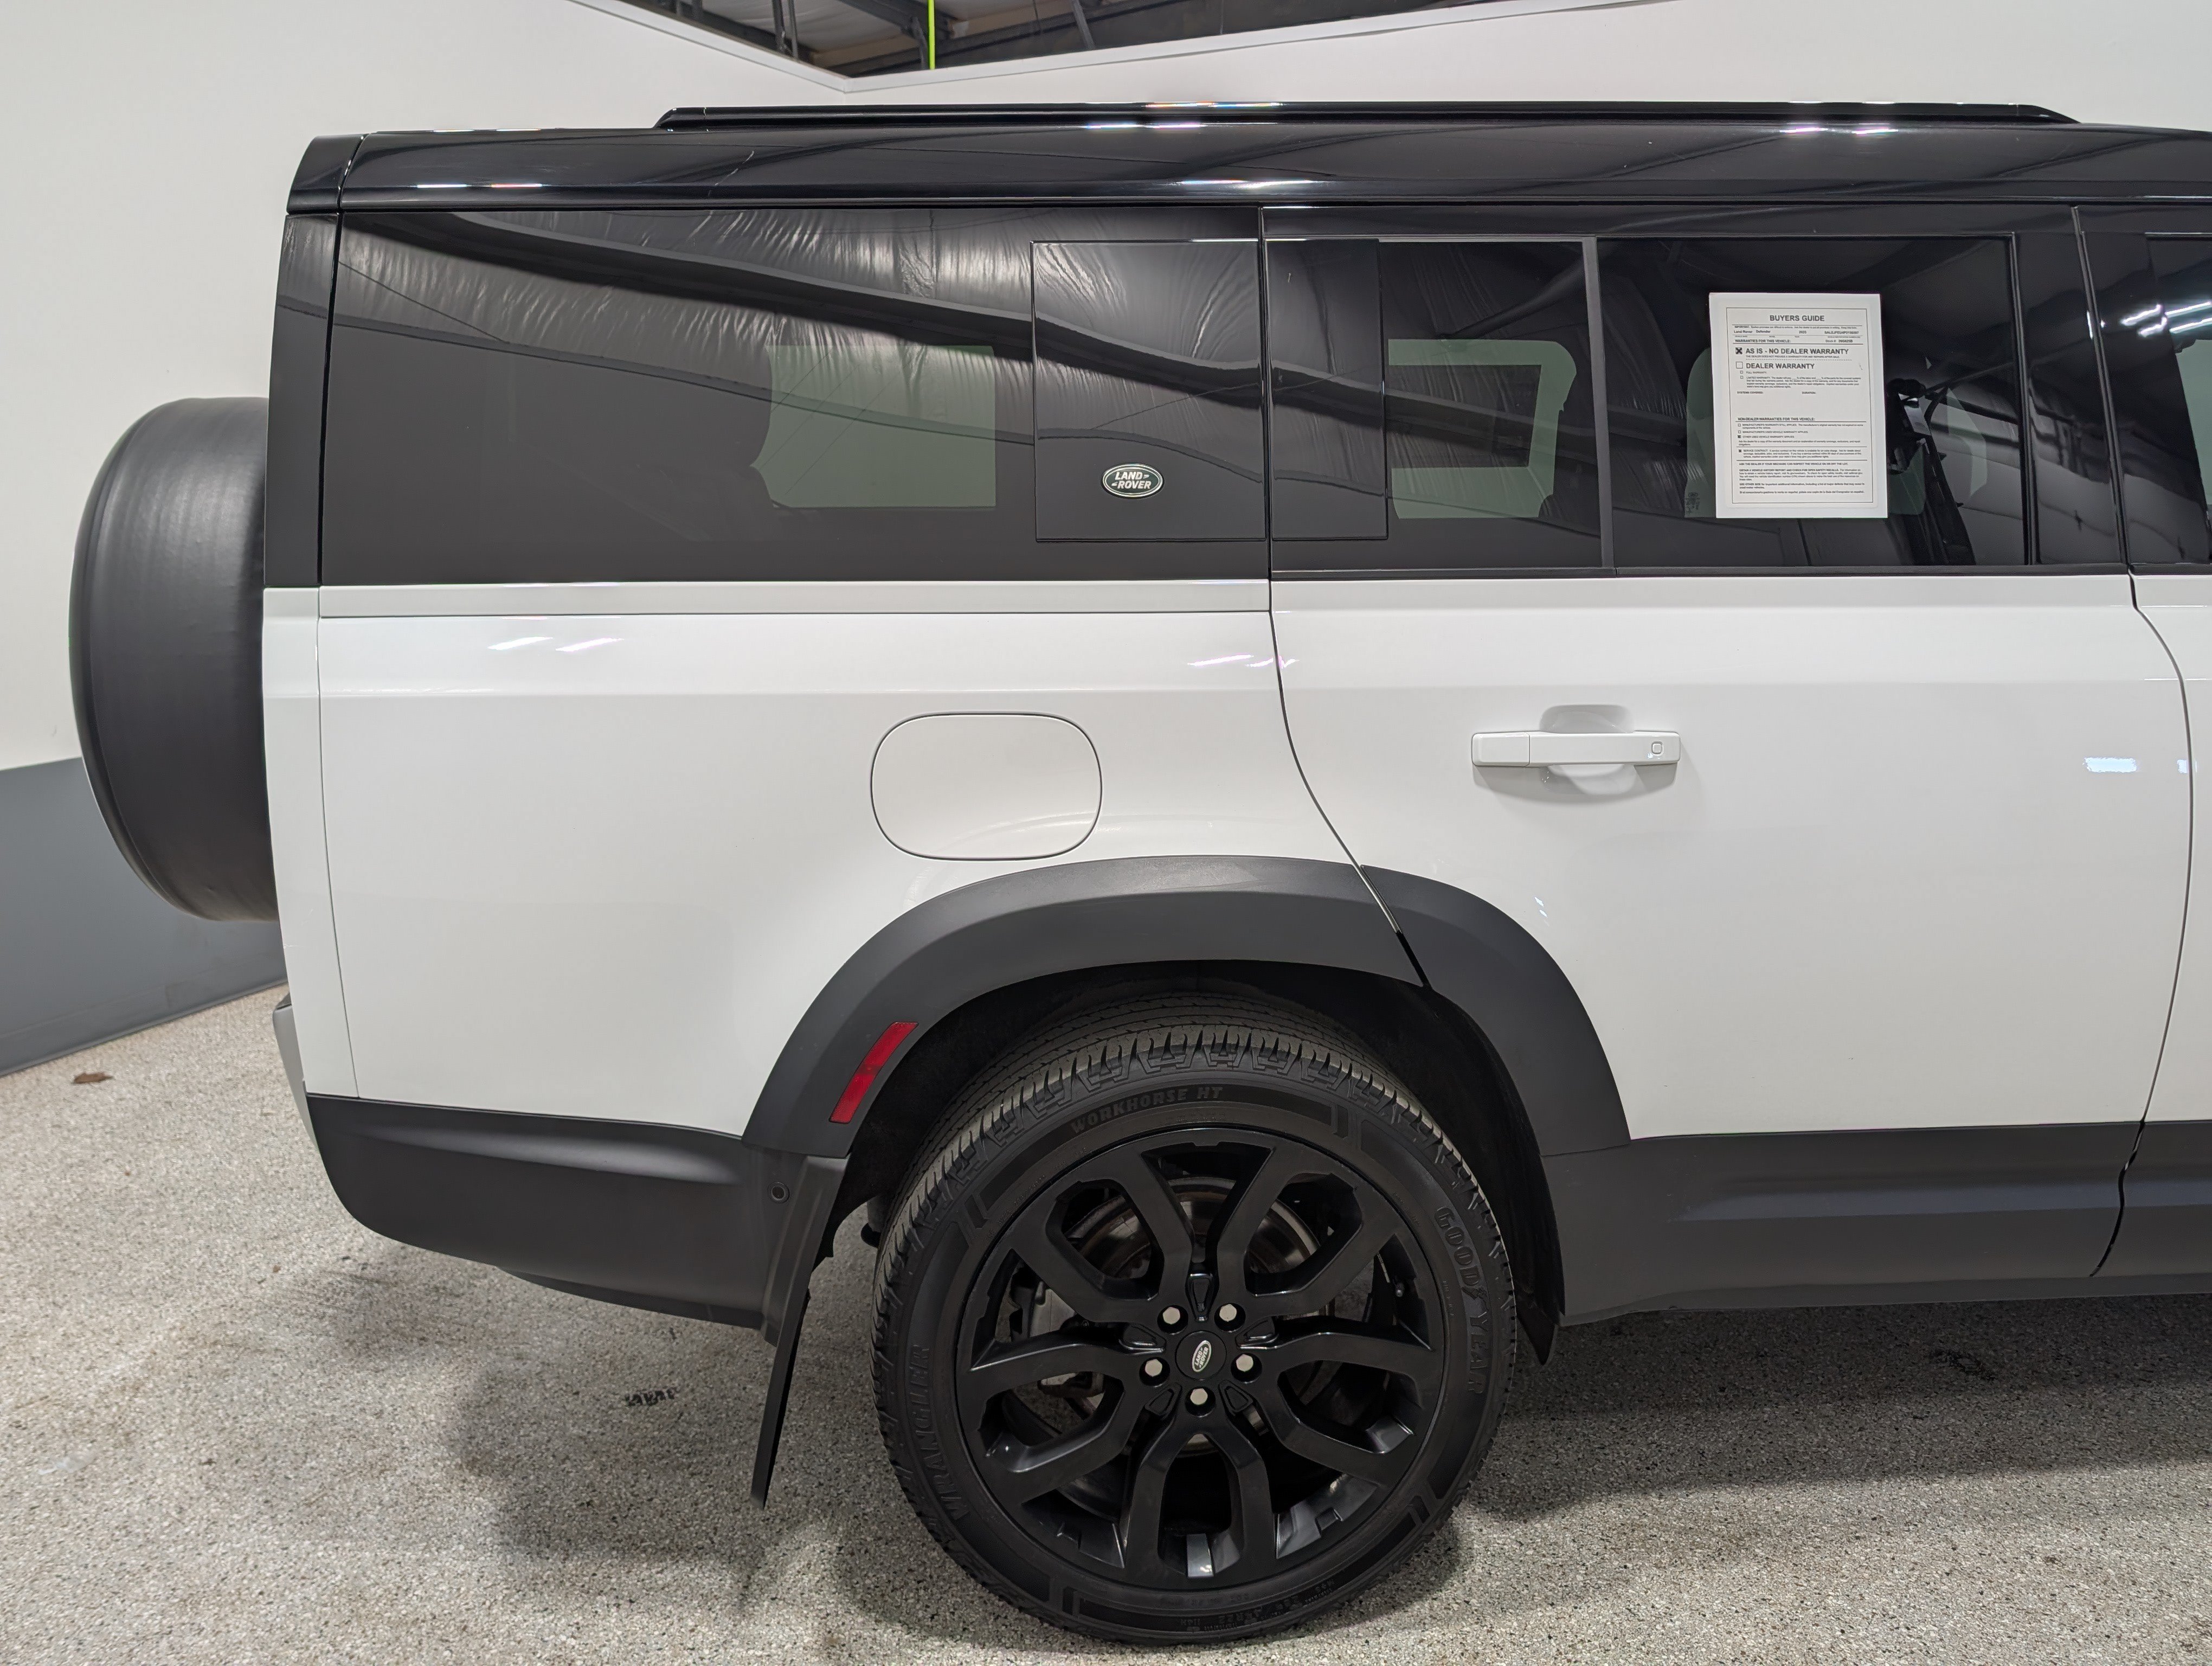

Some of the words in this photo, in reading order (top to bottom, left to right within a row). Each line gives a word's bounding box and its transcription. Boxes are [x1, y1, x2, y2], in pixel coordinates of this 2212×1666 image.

[1115, 471, 1143, 480] LAND
[1117, 480, 1152, 489] ROVER
[1070, 1087, 1188, 1135] WORKHORSE
[1197, 1086, 1223, 1099] HT
[1194, 1350, 1203, 1366] LAND
[1199, 1347, 1209, 1366] ROVER
